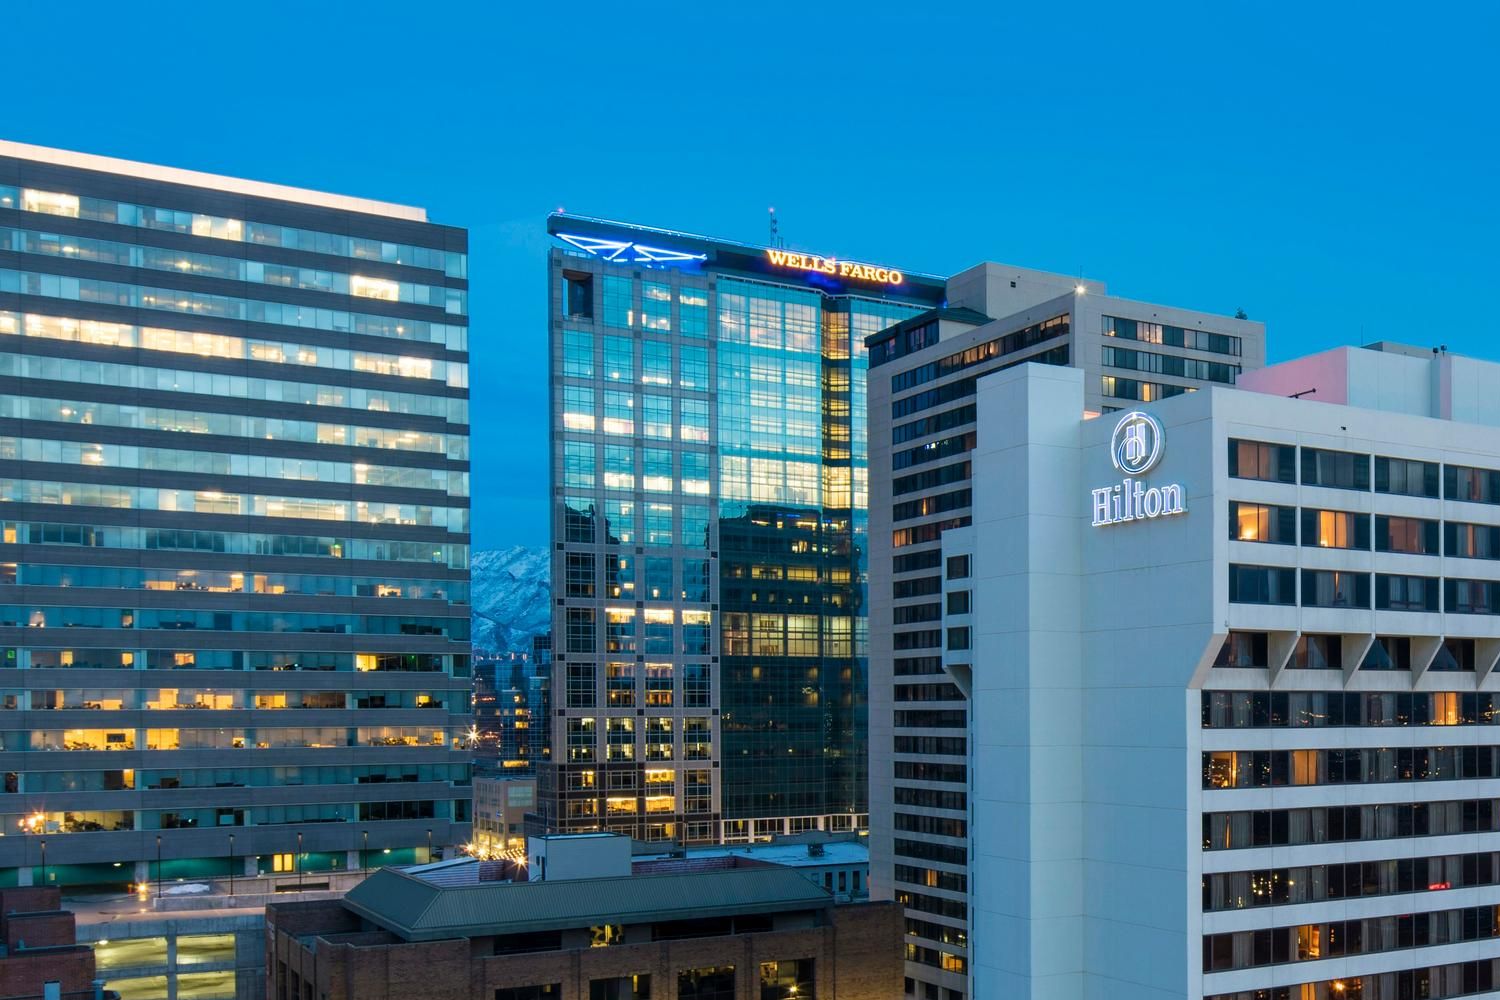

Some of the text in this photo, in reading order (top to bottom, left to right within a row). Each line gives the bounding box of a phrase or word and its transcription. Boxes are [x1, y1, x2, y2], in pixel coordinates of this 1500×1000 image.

[767, 250, 903, 285] WELLS FARGO
[1091, 478, 1184, 527] Hilton
